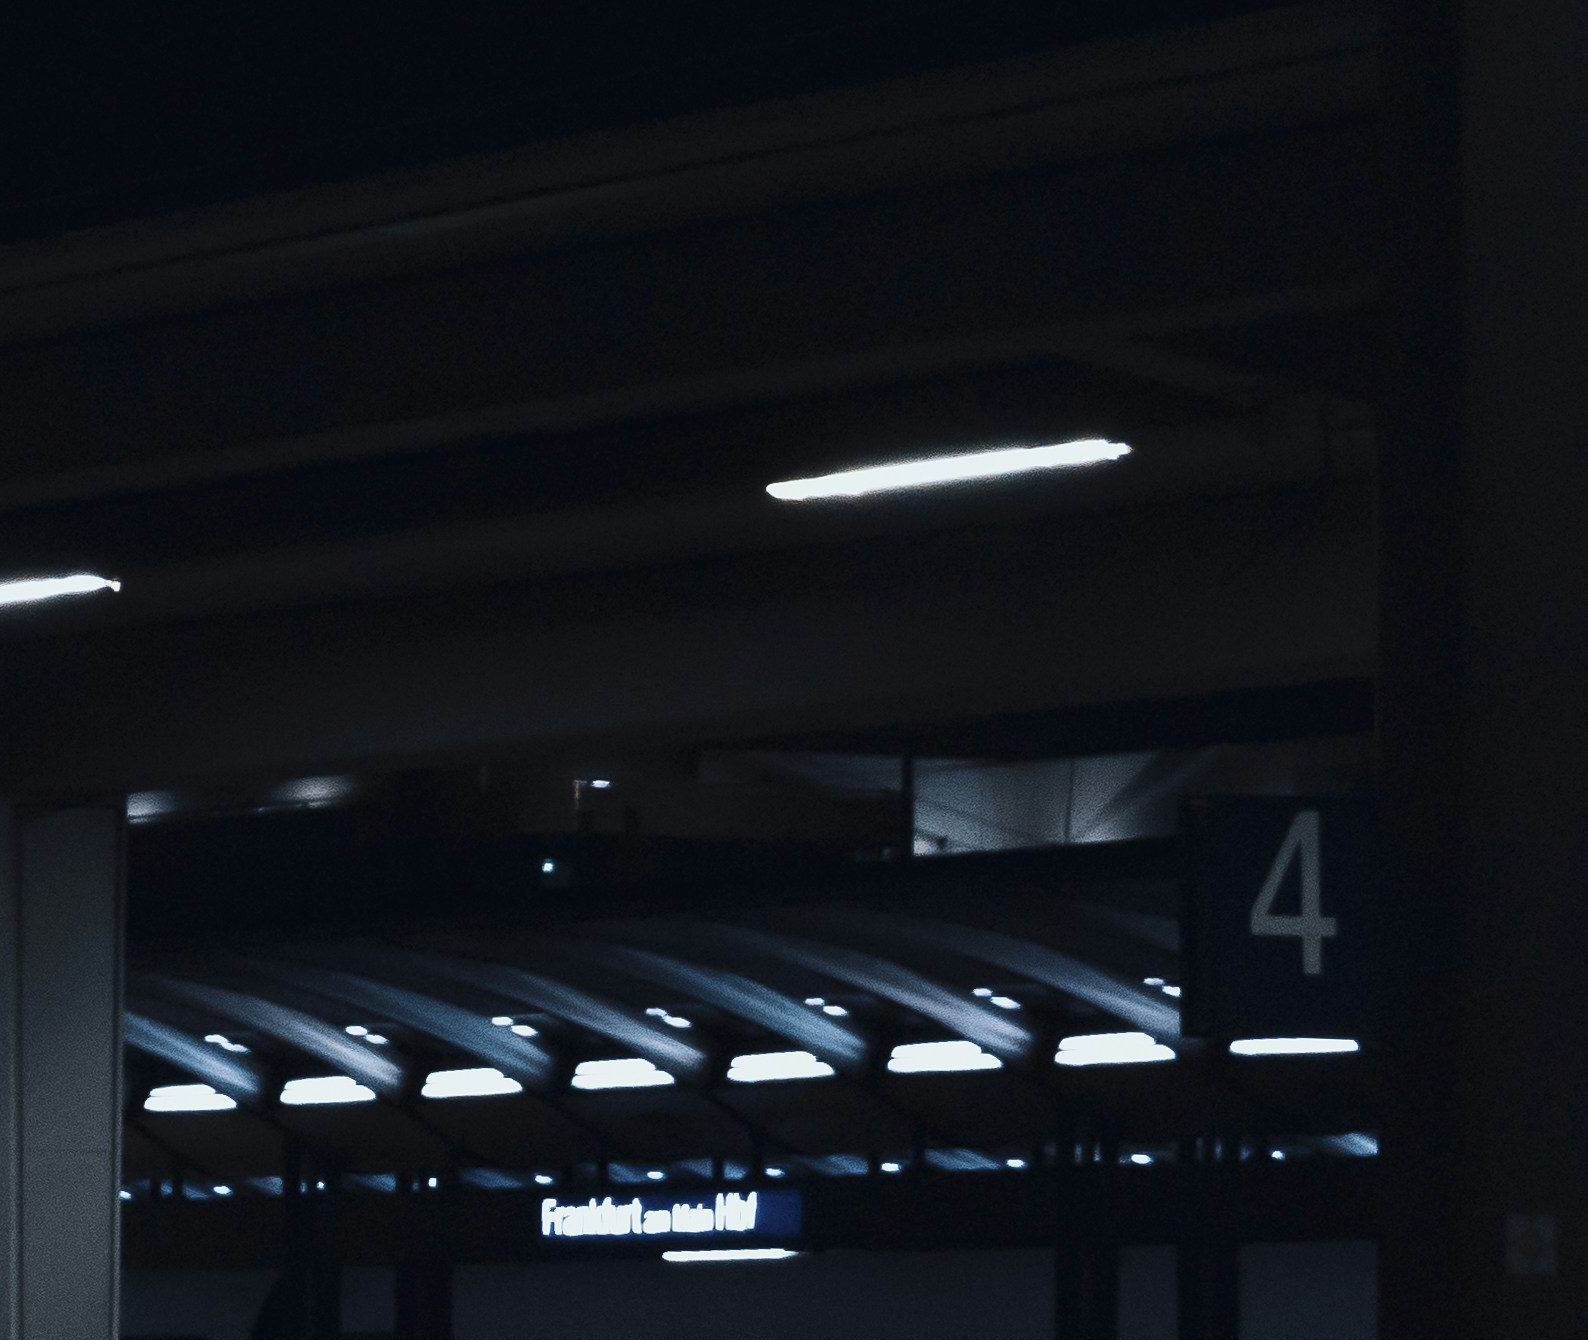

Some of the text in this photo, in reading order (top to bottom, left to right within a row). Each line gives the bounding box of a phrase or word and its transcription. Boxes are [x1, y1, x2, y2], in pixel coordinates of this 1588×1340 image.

[1249, 808, 1338, 975] 4
[542, 1197, 642, 1236] Frankfurt
[715, 1191, 758, 1231] Hbf
